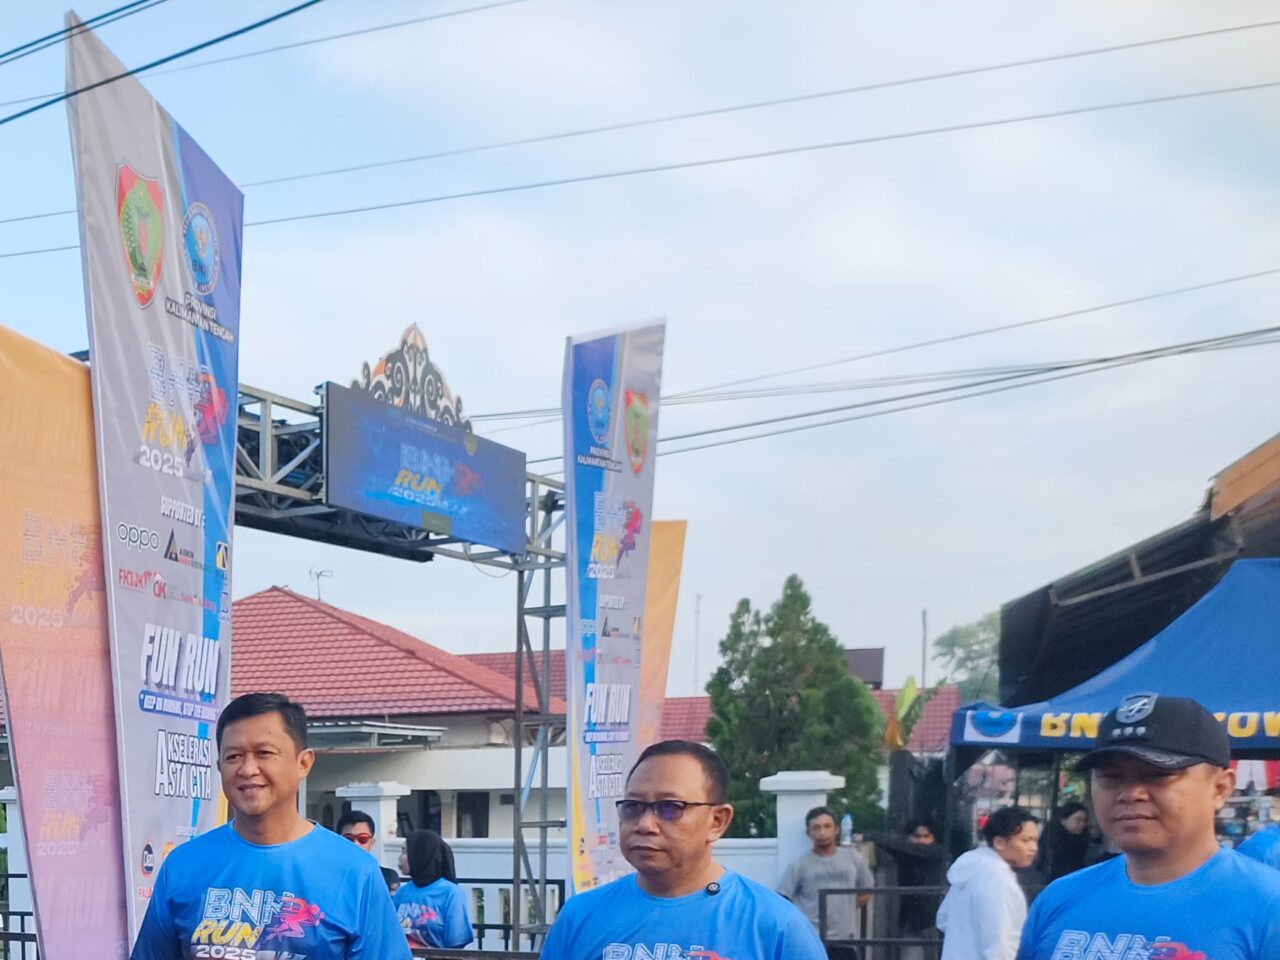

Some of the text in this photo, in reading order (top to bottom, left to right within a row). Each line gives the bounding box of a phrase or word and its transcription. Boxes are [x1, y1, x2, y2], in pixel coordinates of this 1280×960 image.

[138, 445, 183, 477] 2025
[394, 468, 443, 496] RUN
[117, 522, 159, 551] oppo
[588, 563, 616, 579] 2025
[9, 603, 63, 628] 2025
[140, 622, 181, 687] FUN
[181, 632, 220, 696] RUN
[584, 683, 608, 723] FUN
[36, 841, 77, 856] 2025
[190, 920, 265, 949] RUN
